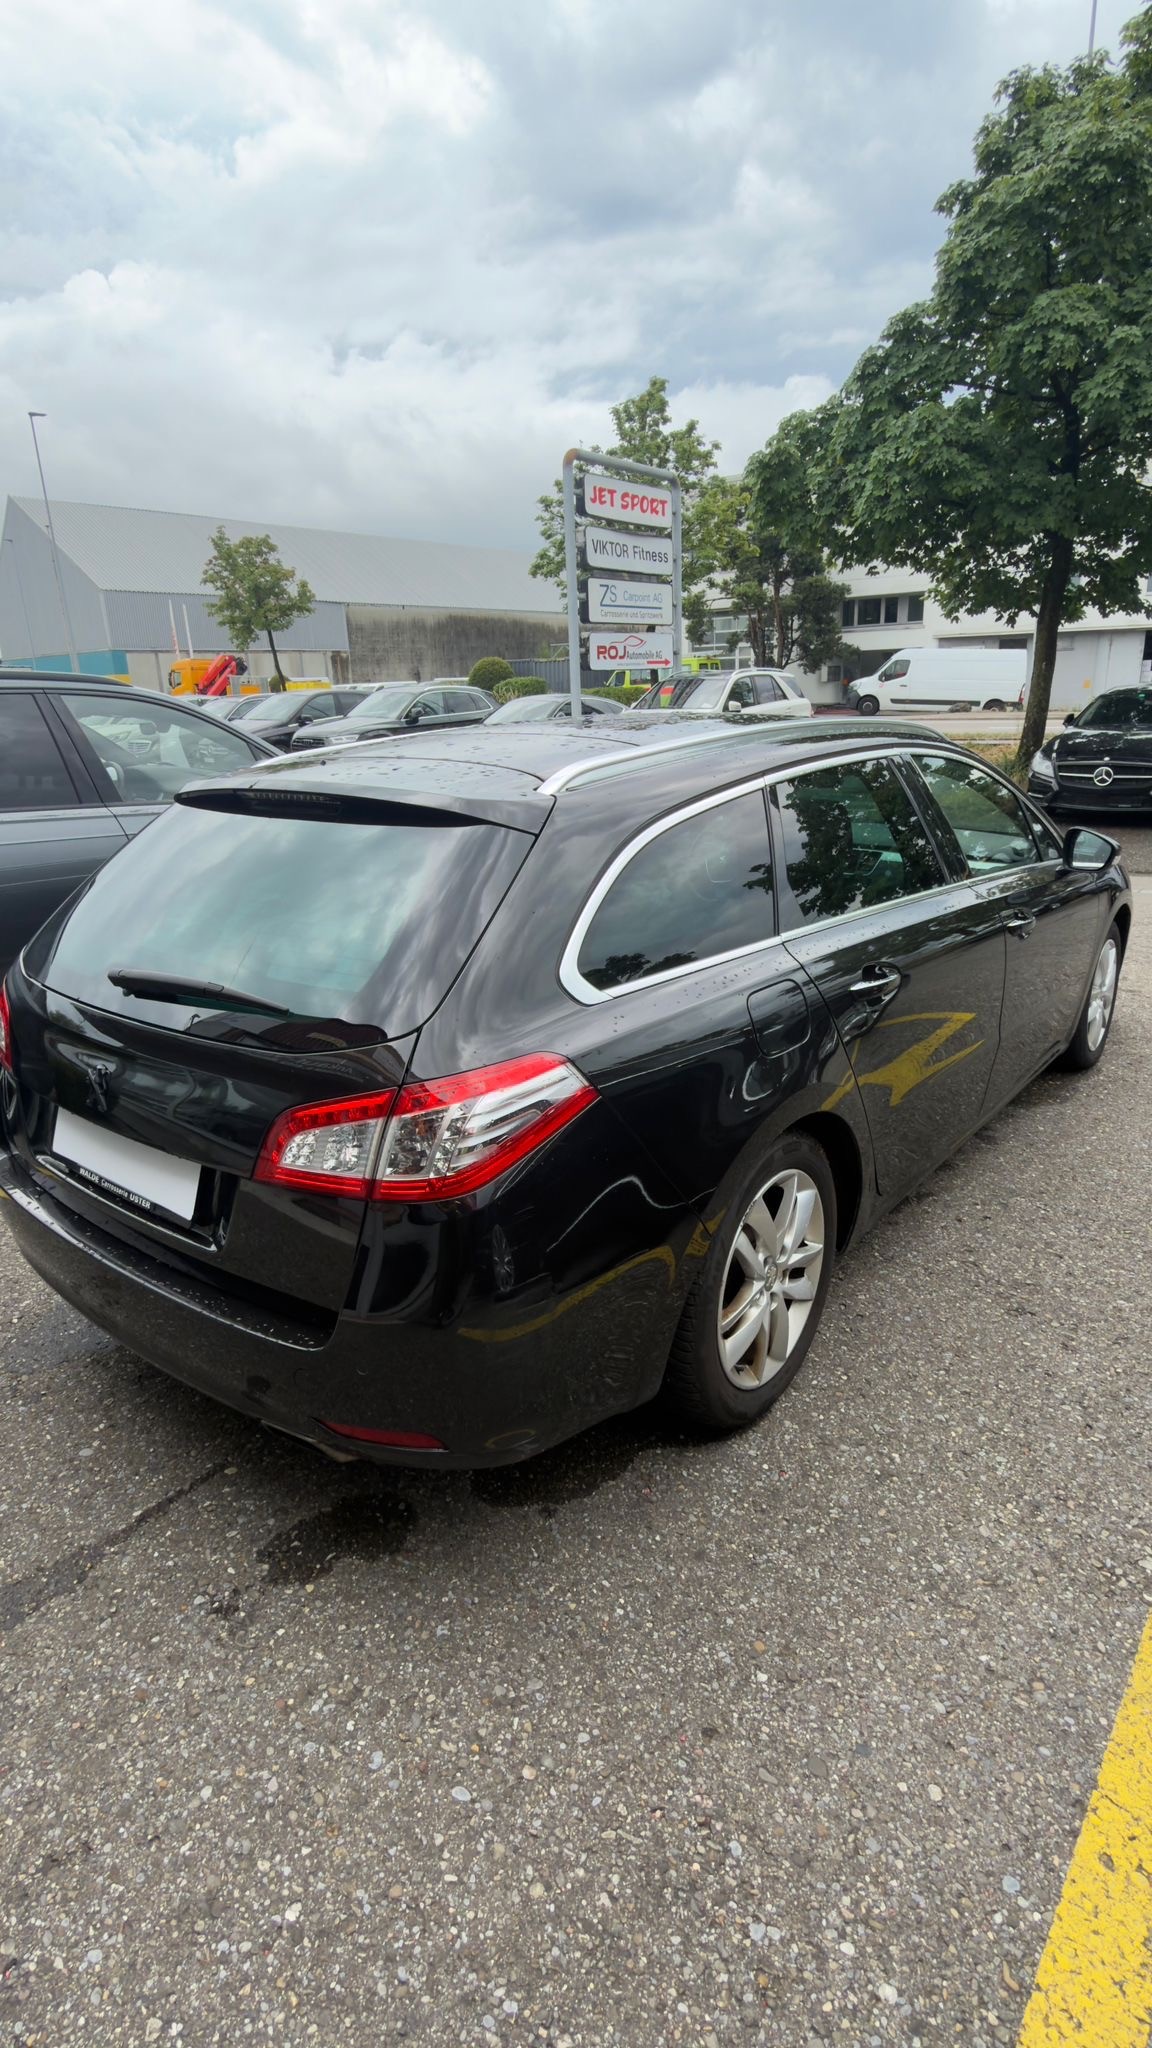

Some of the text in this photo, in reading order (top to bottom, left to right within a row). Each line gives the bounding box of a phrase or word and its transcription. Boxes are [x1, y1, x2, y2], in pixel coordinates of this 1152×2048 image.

[590, 485, 668, 517] JET SPORT
[591, 538, 669, 563] VIKTOR Fitness
[599, 583, 618, 607] ZS
[653, 592, 663, 603] AG
[596, 645, 627, 660] ROJ
[626, 650, 663, 660] Automobile AG
[80, 1167, 151, 1209] WALDE Carrosserie USTER
